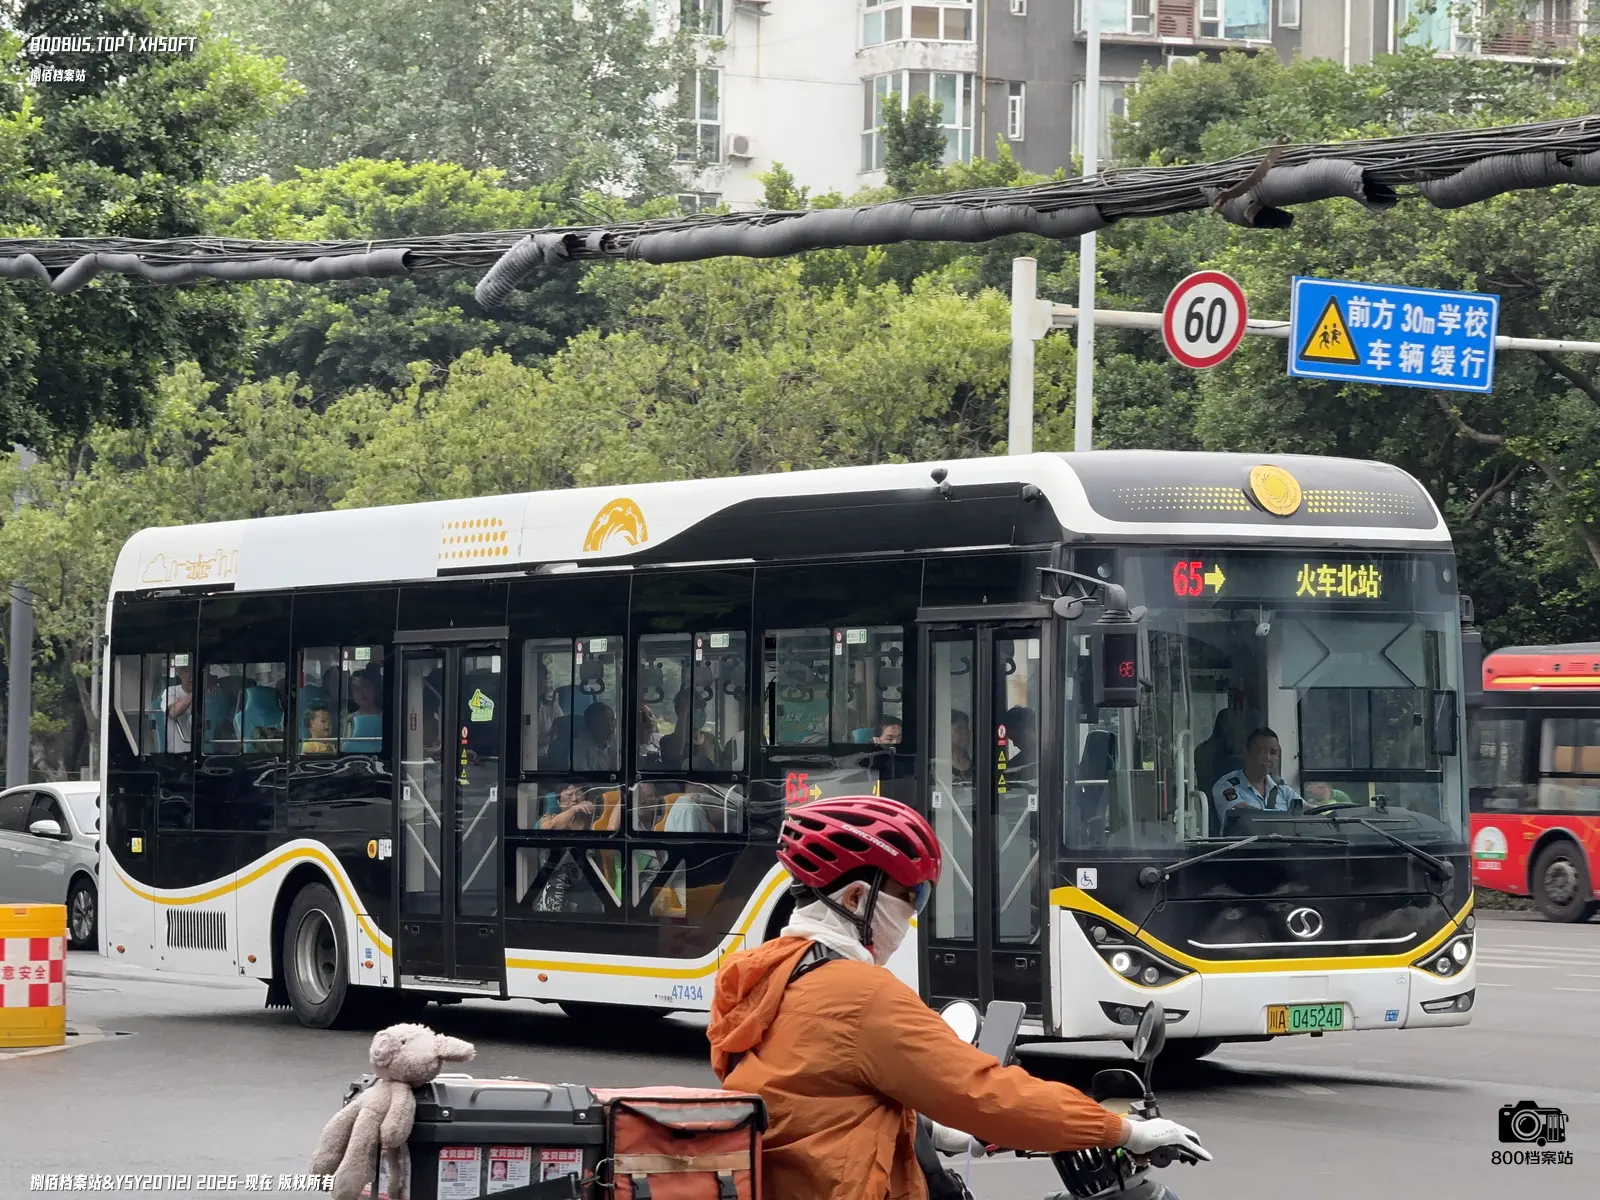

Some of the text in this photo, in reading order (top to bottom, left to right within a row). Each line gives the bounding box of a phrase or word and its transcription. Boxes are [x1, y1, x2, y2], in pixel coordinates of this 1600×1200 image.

[1184, 297, 1227, 344] 60
[1367, 339, 1486, 379] 车辆缓行
[1173, 561, 1203, 597] 65
[1296, 563, 1382, 598] 火车北站
[1119, 661, 1135, 678] 65
[785, 771, 809, 804] 65
[2, 965, 46, 980] 意安全
[671, 985, 704, 1001] 47434
[1269, 1008, 1343, 1029] 川A 04524D
[440, 1149, 475, 1159] 宝贝回家
[490, 1148, 524, 1158] 宝贝回家
